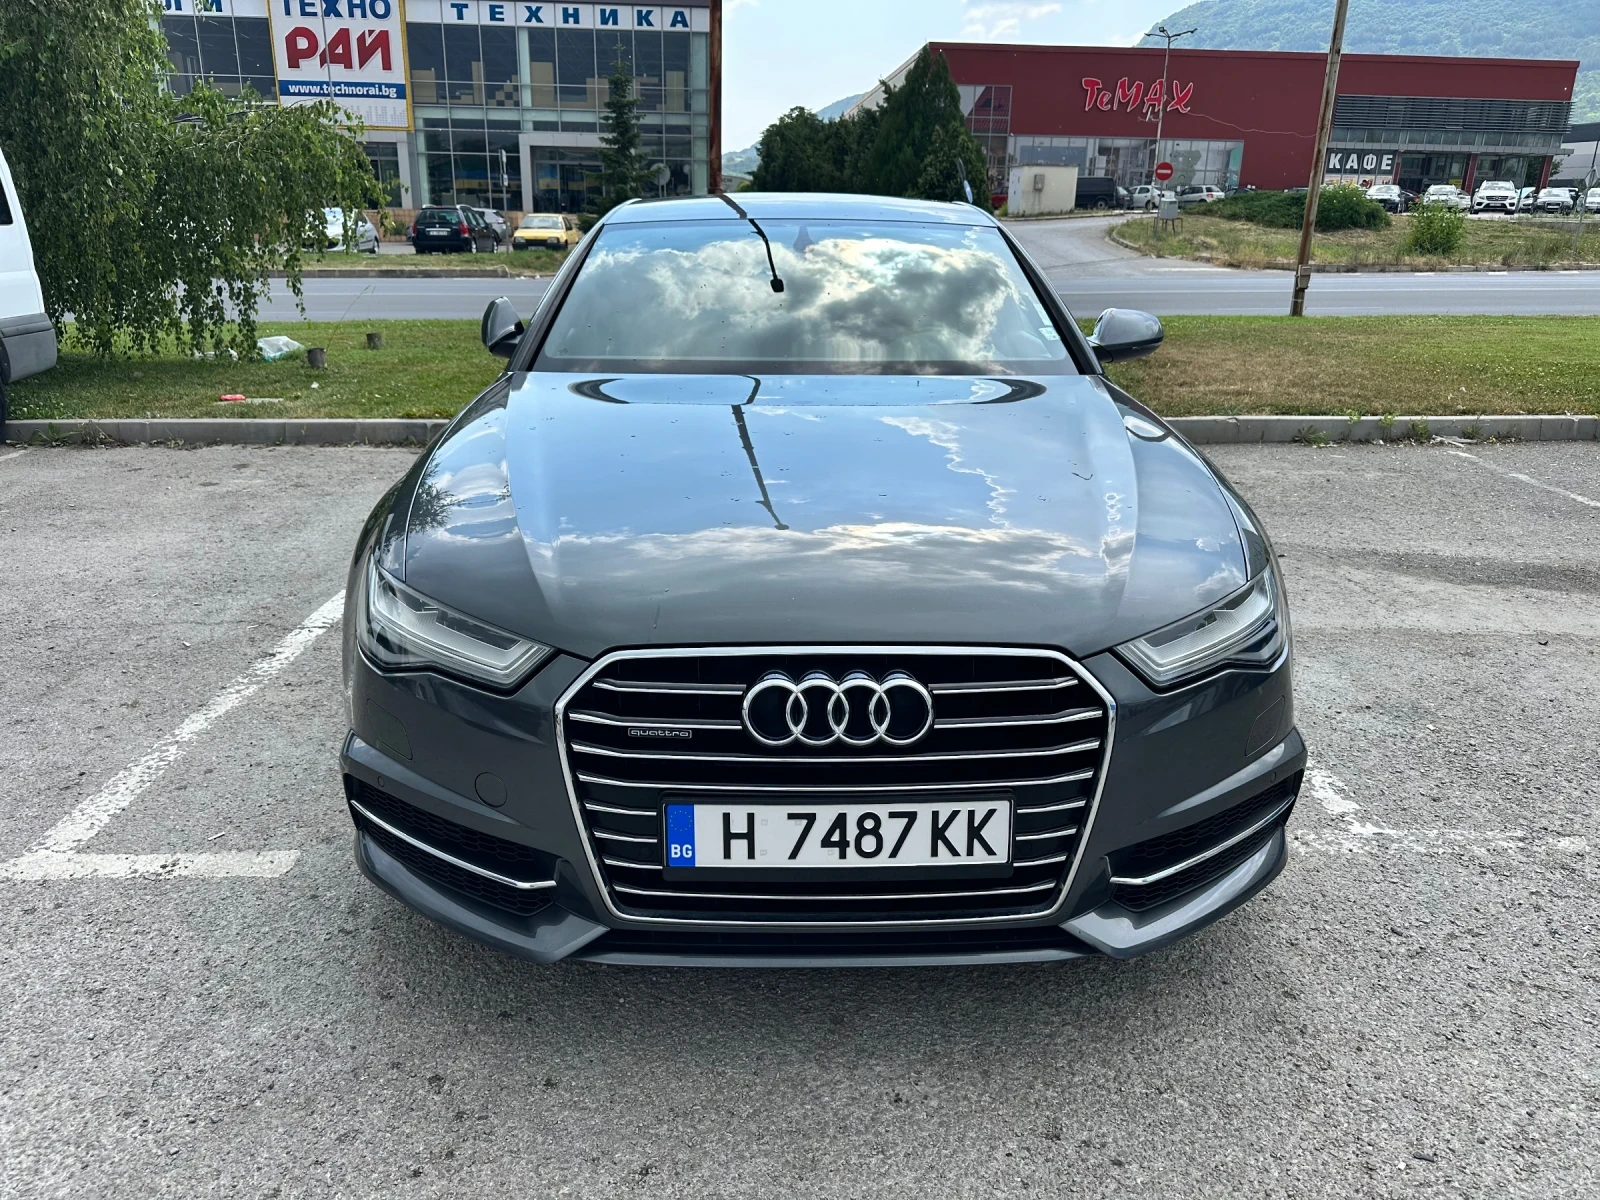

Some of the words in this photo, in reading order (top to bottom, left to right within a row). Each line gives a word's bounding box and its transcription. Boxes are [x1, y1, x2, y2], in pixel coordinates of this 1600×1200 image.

[450, 2, 690, 28] ТЕХНИКА
[284, 26, 393, 72] РАЙ
[288, 83, 398, 98] www.technorai.bg
[1328, 152, 1394, 171] КАФЕ
[630, 729, 690, 738] quattro
[722, 811, 756, 861] H
[787, 811, 918, 861] 7487
[930, 808, 998, 858] KK
[671, 844, 693, 858] BG
